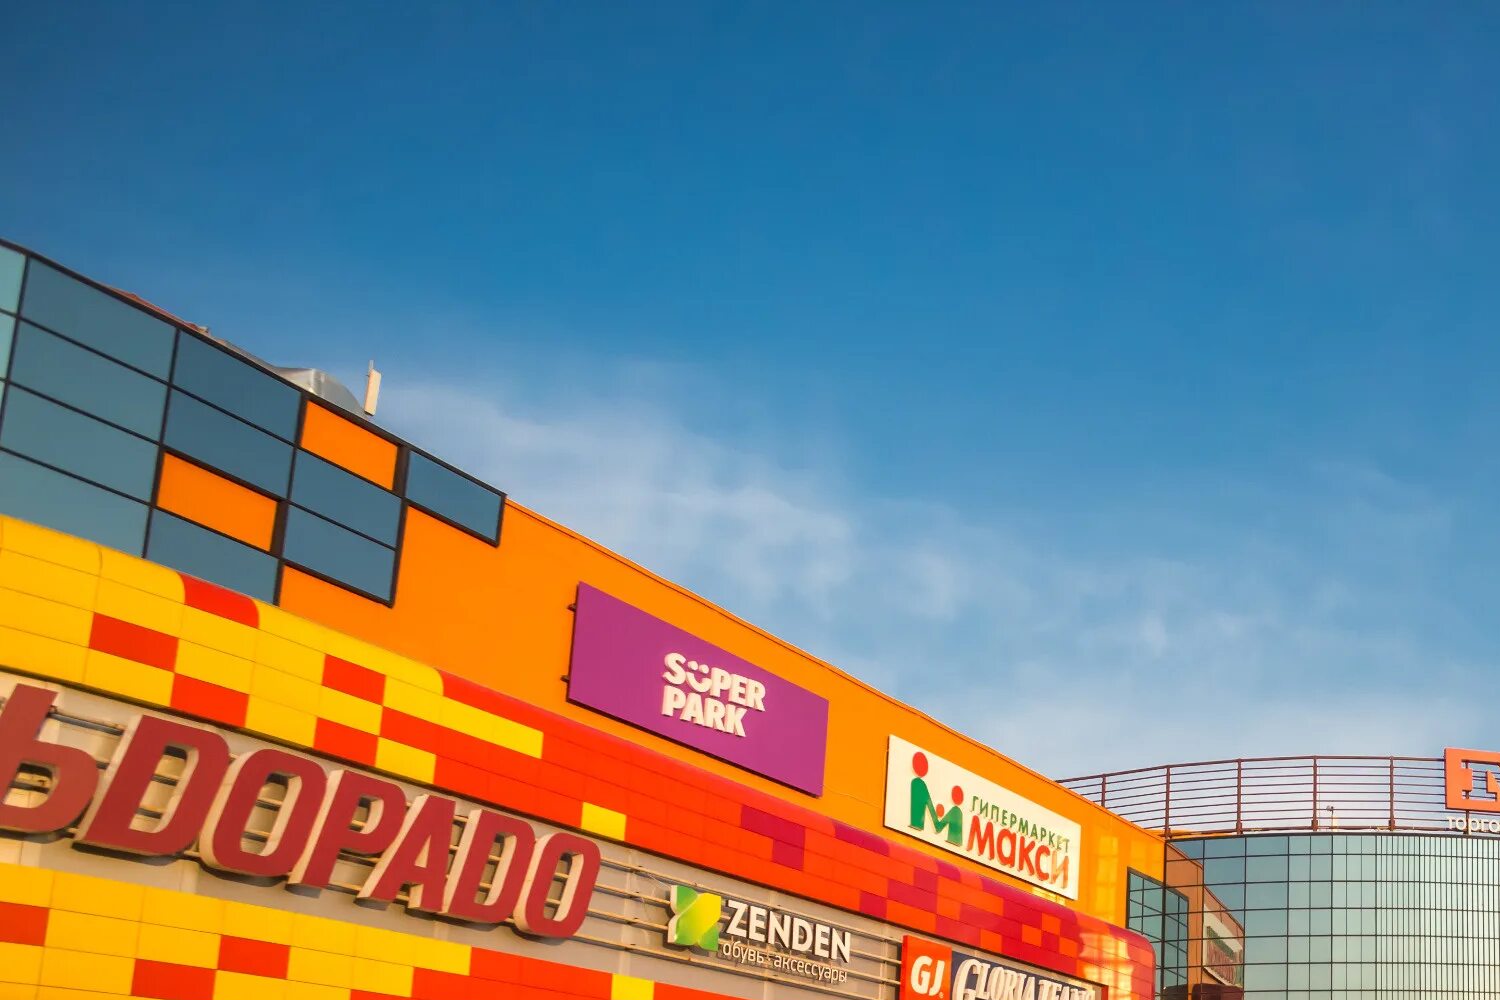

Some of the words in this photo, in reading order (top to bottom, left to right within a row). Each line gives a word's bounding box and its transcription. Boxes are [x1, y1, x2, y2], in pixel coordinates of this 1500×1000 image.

[661, 685, 747, 737] PARK
[971, 795, 1070, 853] ГИПЕРМАРКЕТ
[726, 900, 851, 963] ZENDEN
[722, 940, 764, 964] обувь
[773, 954, 848, 983] аксессуары
